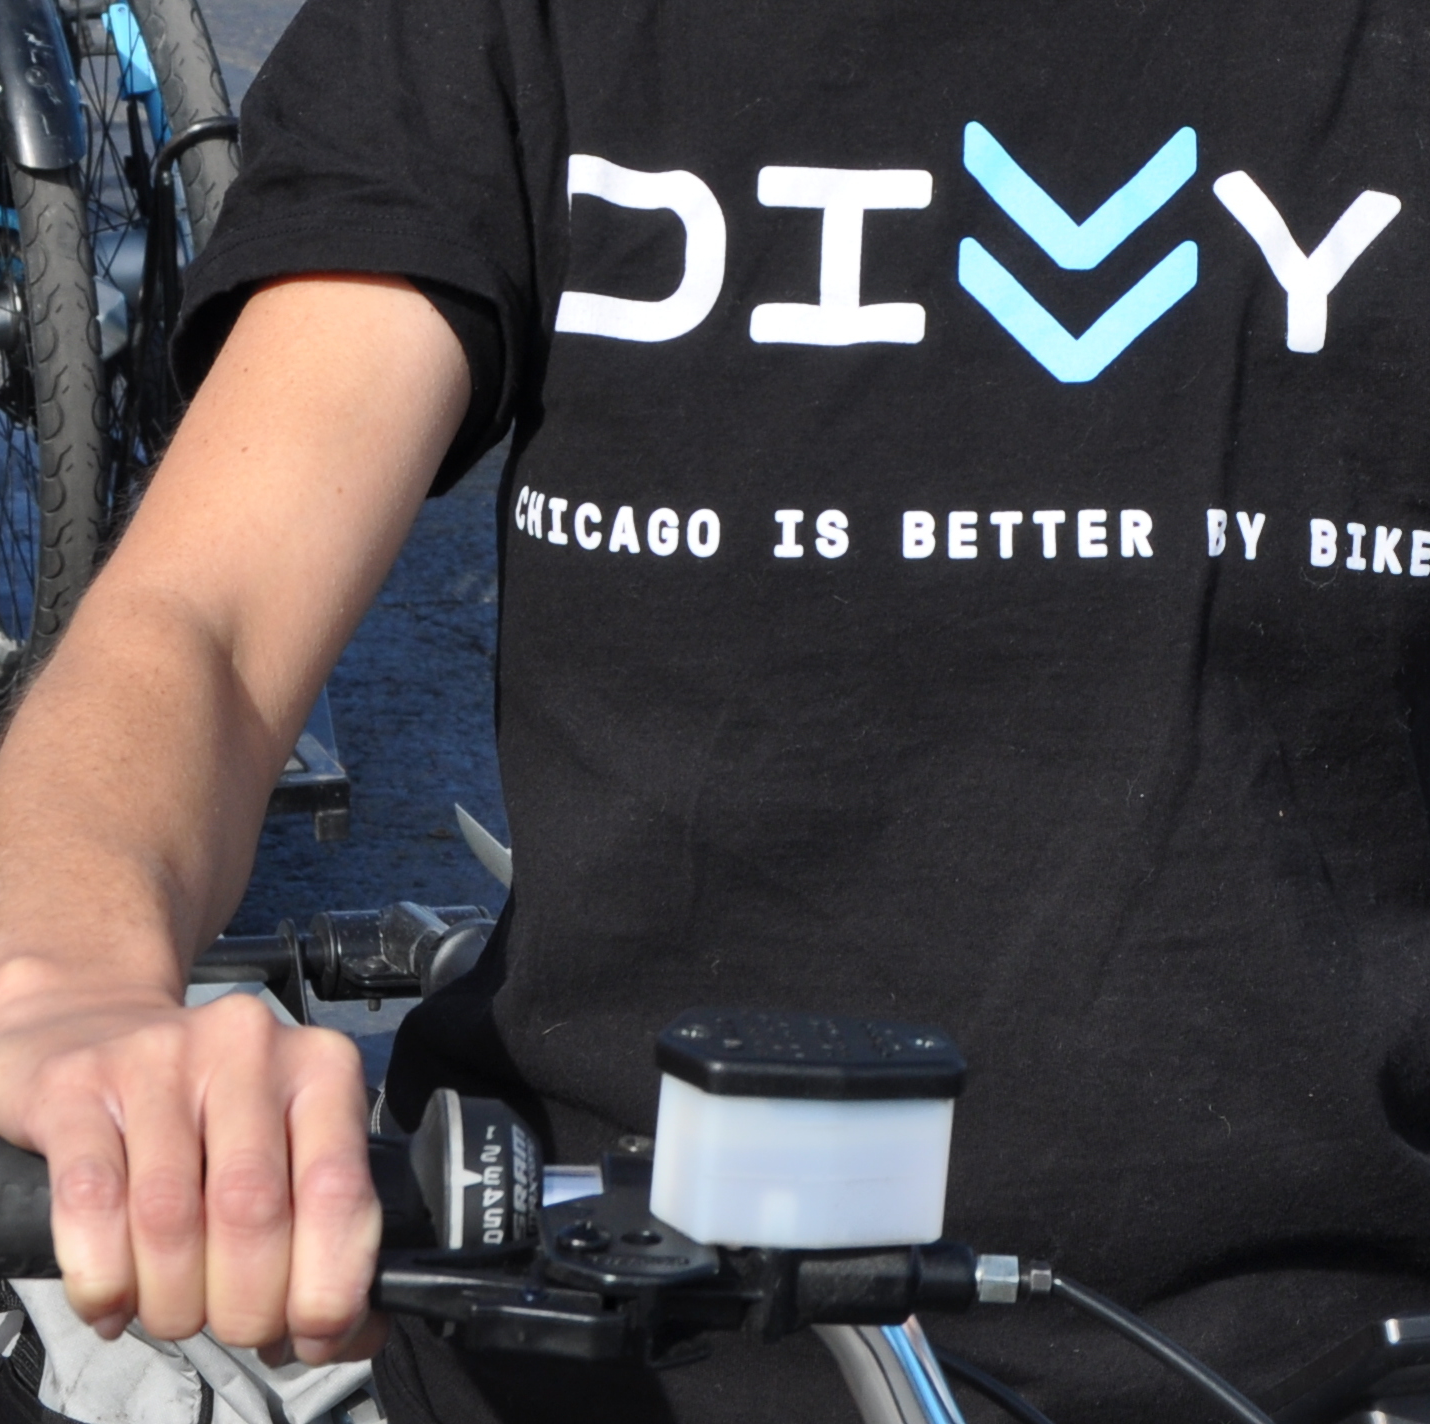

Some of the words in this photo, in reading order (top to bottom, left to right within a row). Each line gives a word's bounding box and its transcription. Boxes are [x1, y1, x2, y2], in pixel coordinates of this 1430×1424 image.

[555, 121, 1402, 383] DIVVY
[514, 486, 721, 557] CHICAGO
[773, 509, 850, 558] IS
[903, 509, 1154, 559] BETTER
[1207, 508, 1266, 561] BY
